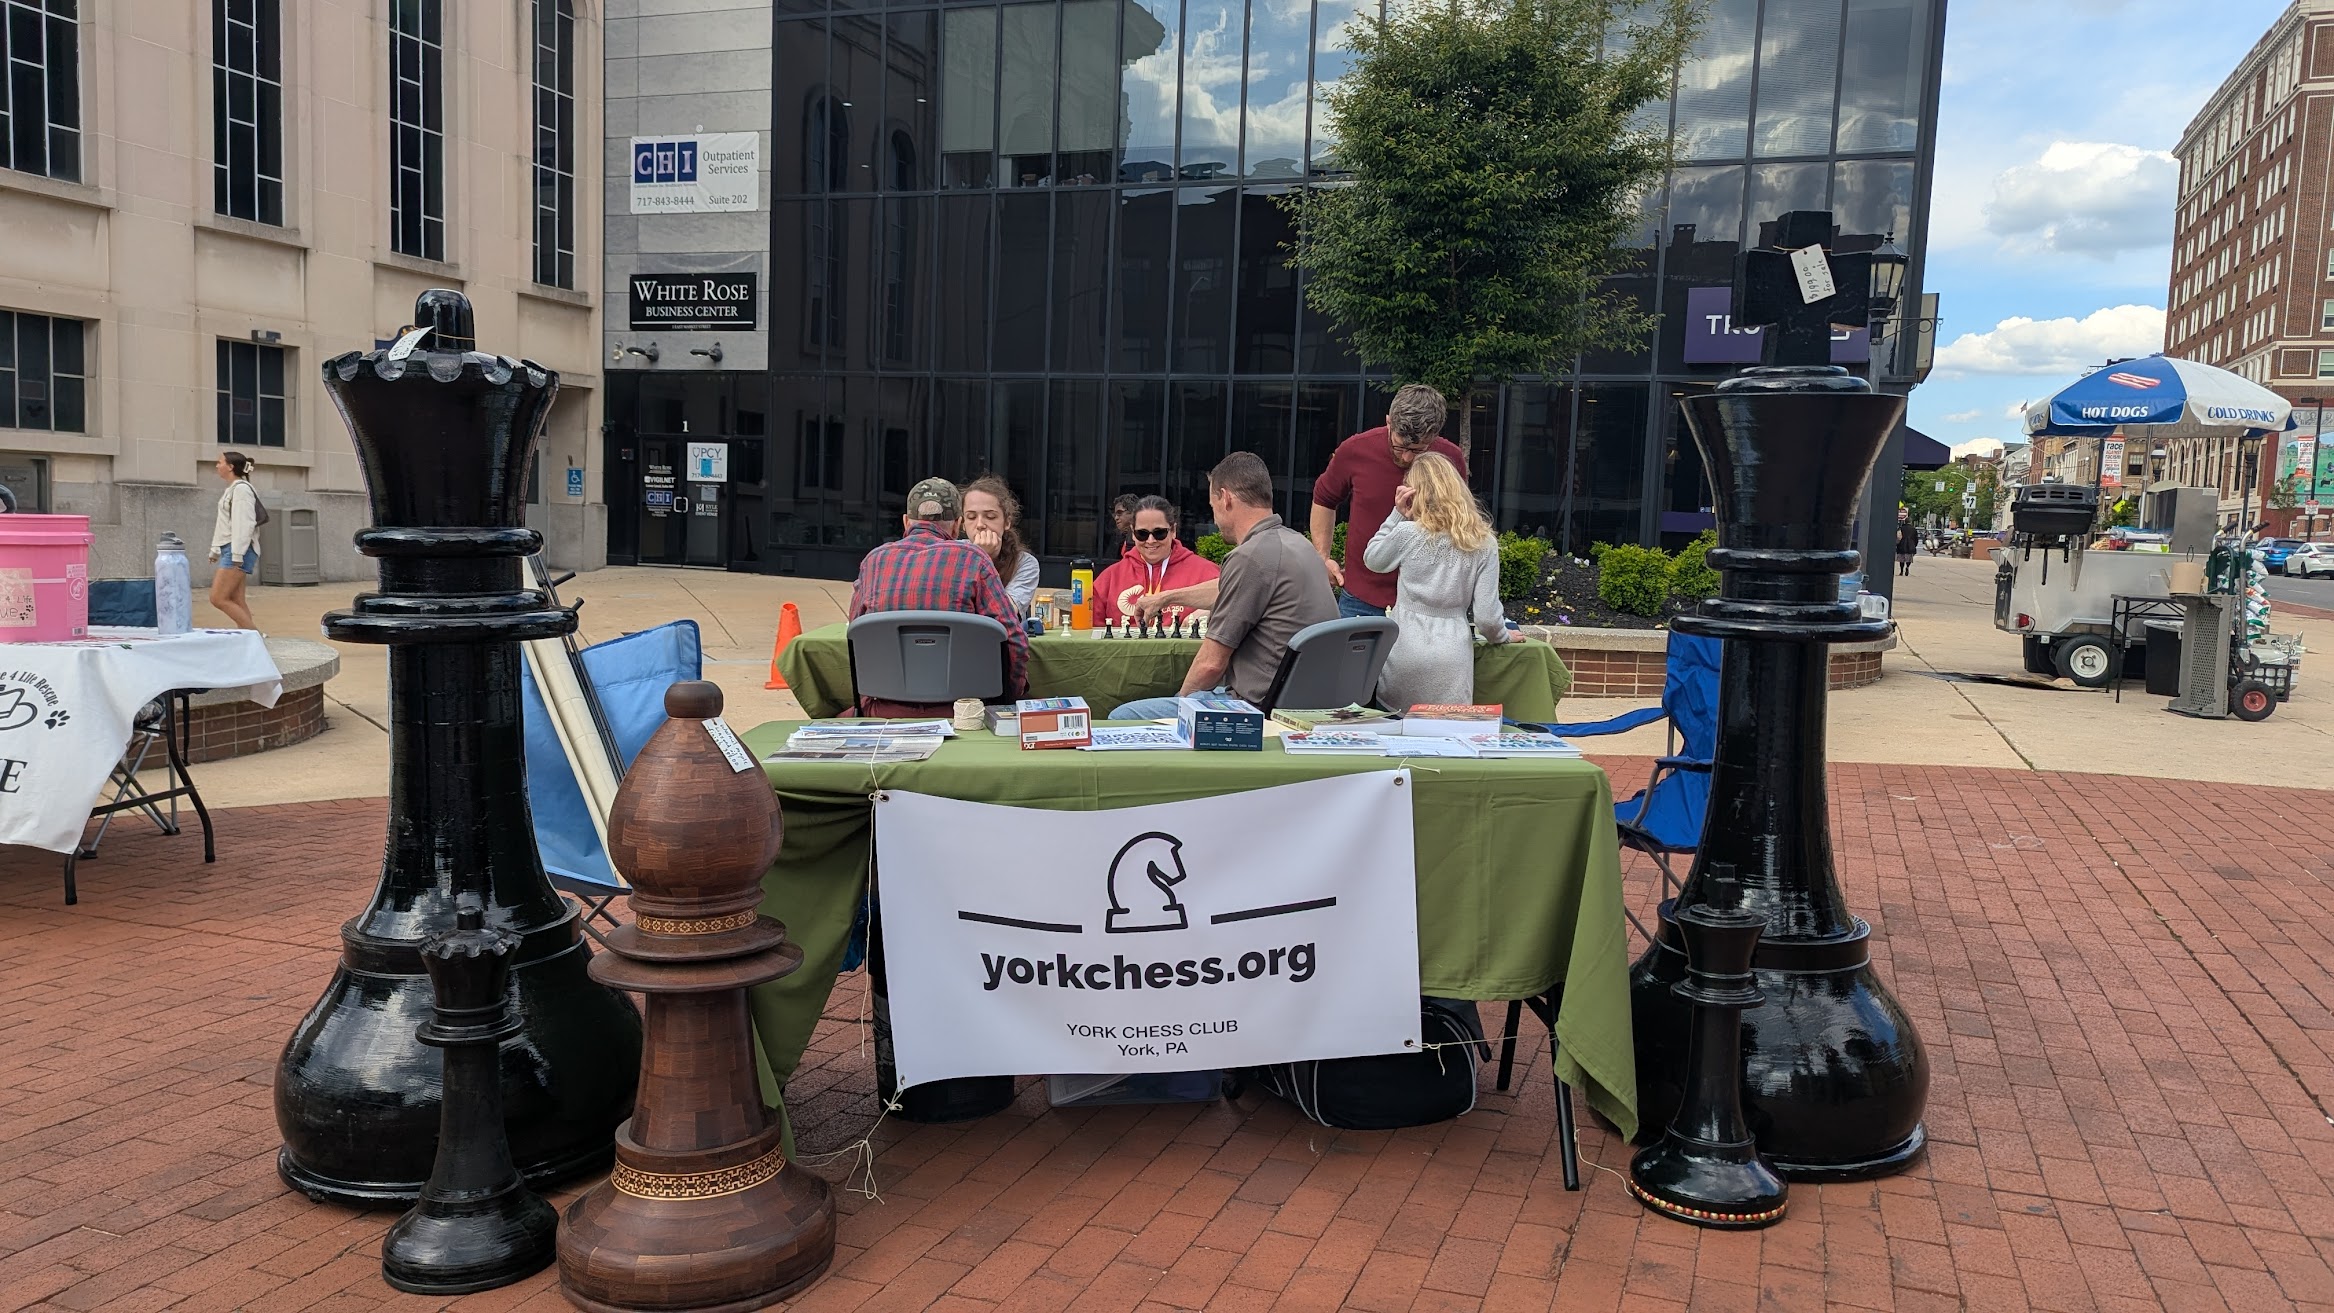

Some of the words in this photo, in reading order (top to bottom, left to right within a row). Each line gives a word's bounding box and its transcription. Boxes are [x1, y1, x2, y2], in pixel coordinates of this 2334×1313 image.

[637, 150, 692, 175] CHI
[702, 150, 755, 163] Outpatient
[708, 164, 749, 175] Services
[637, 196, 695, 207] 717-843-8444
[708, 195, 730, 205] Suite
[731, 194, 748, 204] 202
[634, 280, 698, 301] WHITE
[702, 279, 749, 301] ROSE
[645, 306, 694, 317] BUSINESS
[694, 306, 739, 317] CENTER
[2082, 406, 2108, 419] HOT
[2112, 405, 2149, 418] DOGS
[2207, 405, 2237, 420] COLD
[2238, 408, 2276, 424] DRINKS
[682, 420, 690, 433] 1
[2106, 442, 2124, 450] race
[648, 492, 671, 502] CHI
[16, 594, 33, 605] Life
[9, 670, 19, 682] 4
[18, 671, 38, 685] Life
[33, 677, 60, 707] Rescue
[0, 758, 28, 794] E
[980, 941, 1317, 991] yorkchess.org
[1066, 1023, 1118, 1040] YORK
[1121, 1023, 1184, 1039] CHESS
[1188, 1019, 1239, 1036] CLUB
[1117, 1042, 1160, 1058] York,
[1164, 1041, 1189, 1055] PA
